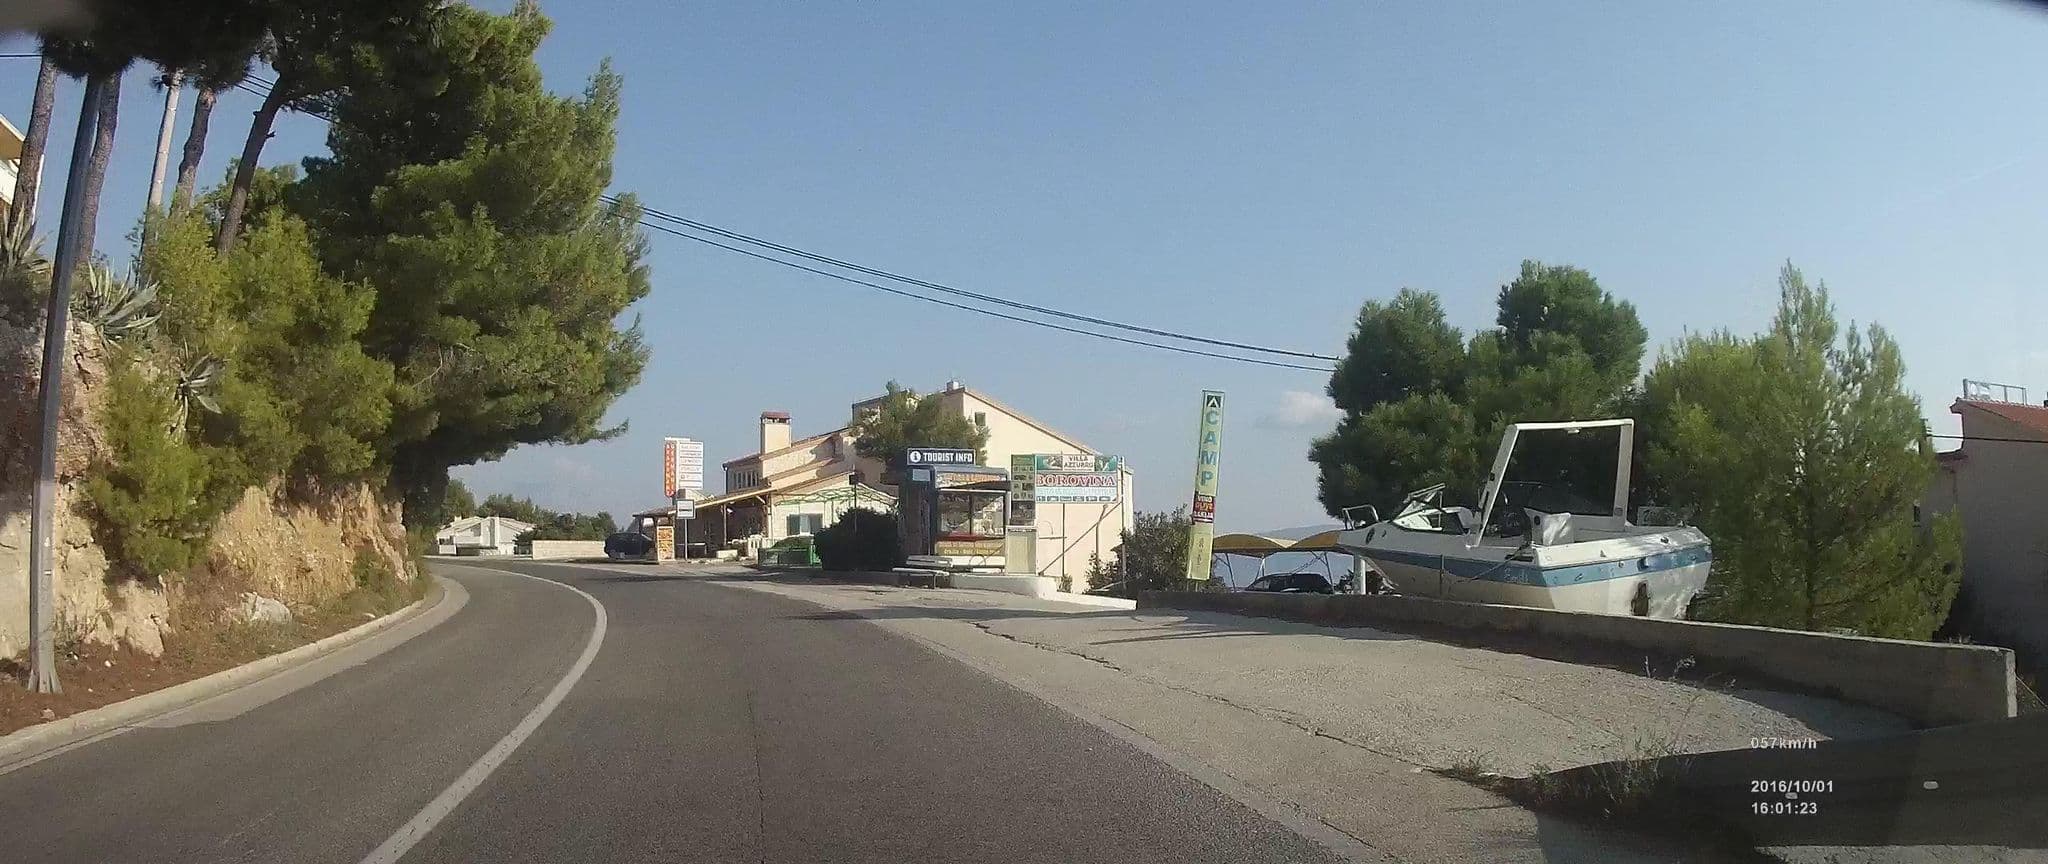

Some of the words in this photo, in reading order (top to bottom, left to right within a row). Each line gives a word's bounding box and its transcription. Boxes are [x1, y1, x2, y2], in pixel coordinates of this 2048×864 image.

[1200, 410, 1219, 486] CAMP
[922, 452, 954, 462] TOURIST
[955, 453, 973, 463] INFO
[1036, 474, 1116, 485] BOROVINA
